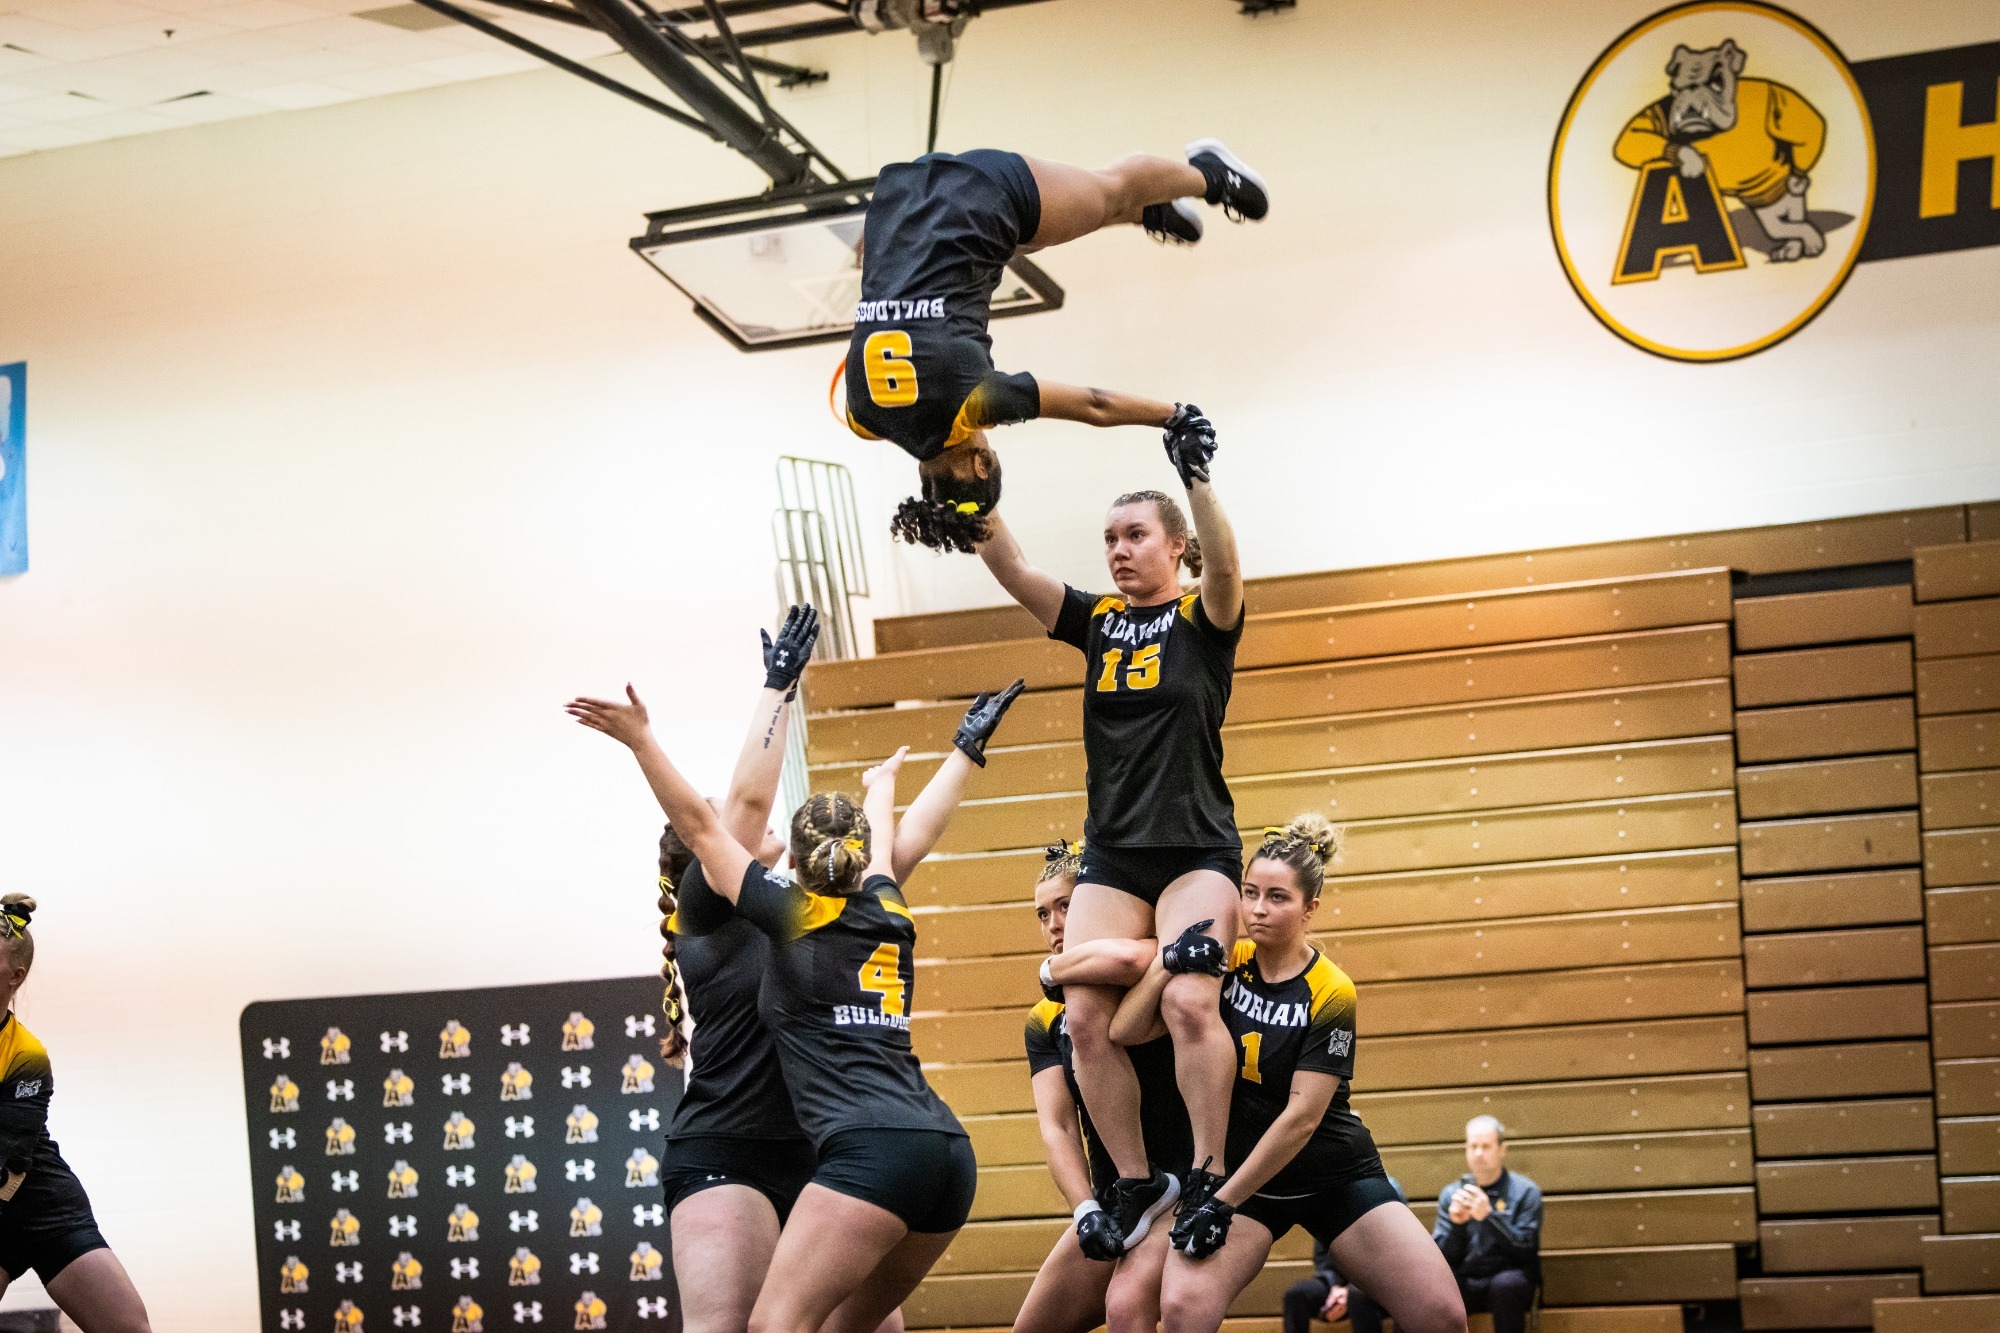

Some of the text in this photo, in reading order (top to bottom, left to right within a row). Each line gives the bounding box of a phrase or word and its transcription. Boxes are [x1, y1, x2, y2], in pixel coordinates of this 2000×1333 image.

[1611, 154, 1748, 286] A
[1096, 643, 1161, 693] 15
[857, 941, 906, 1016] 4
[1223, 974, 1310, 1028] ADRIAN
[1240, 1030, 1263, 1085] 1
